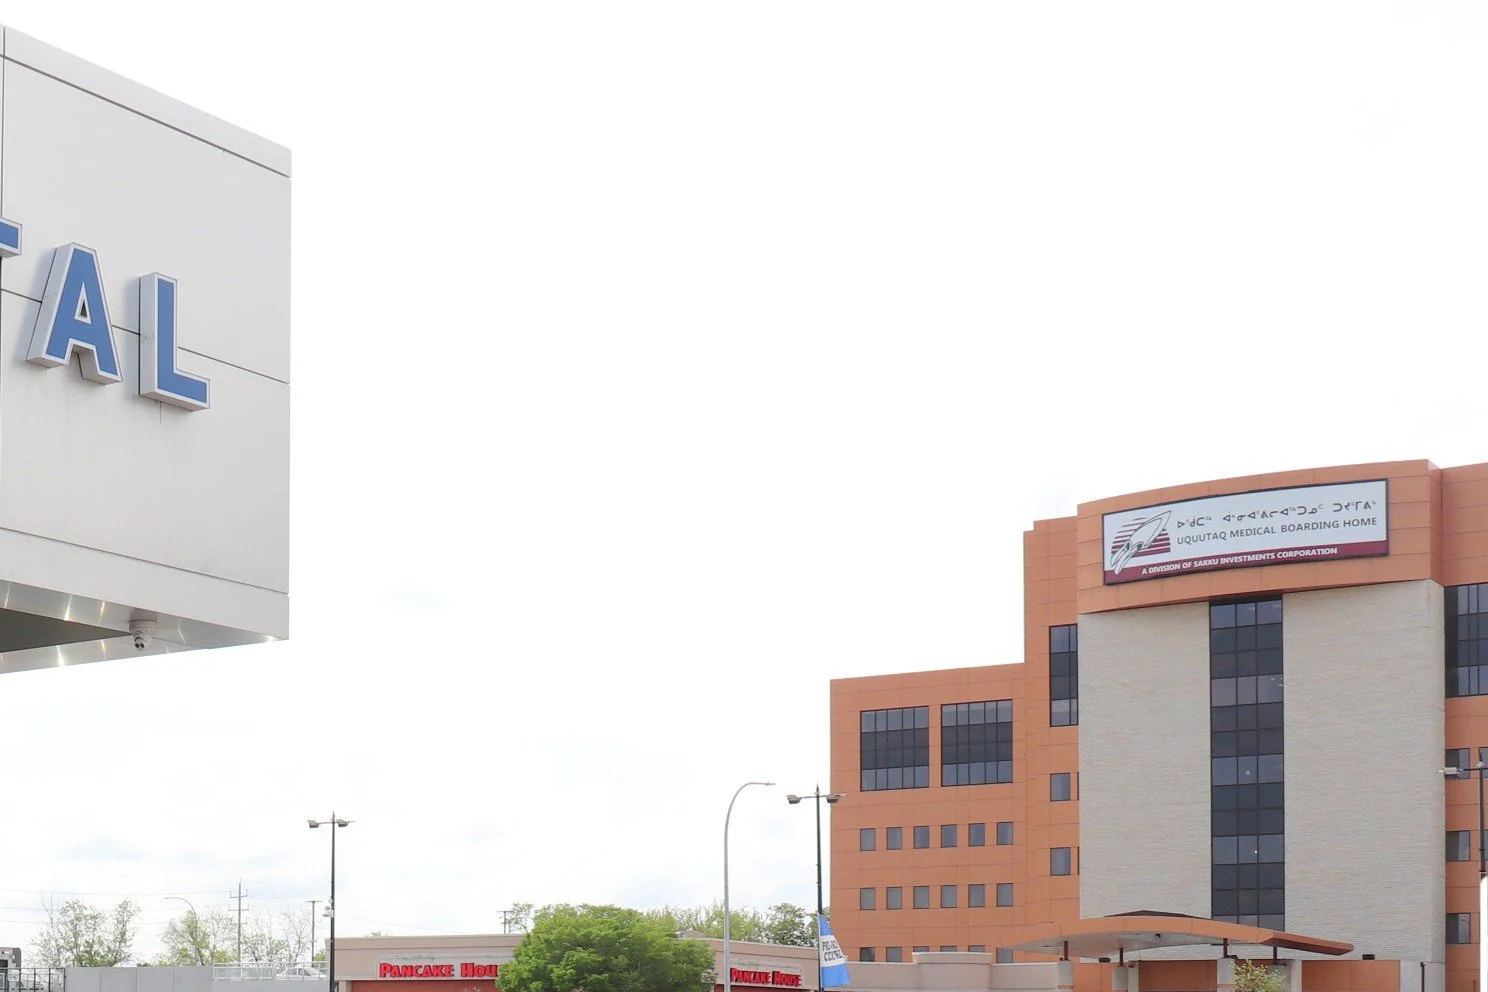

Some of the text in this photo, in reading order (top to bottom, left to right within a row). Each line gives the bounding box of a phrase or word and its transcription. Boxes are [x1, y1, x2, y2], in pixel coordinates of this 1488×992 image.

[1177, 517, 1378, 546] UQUUTAQ MEDICAL BOARDING HOME
[1148, 563, 1180, 574] DIVISION
[1181, 562, 1192, 570] OF
[1193, 558, 1219, 568] SAKKU
[1219, 552, 1275, 565] INVESTMENTS
[1276, 547, 1338, 559] CORPORATION
[379, 962, 499, 978] PANCAKE HOU
[730, 967, 802, 987] PANCAKE HOUSE
